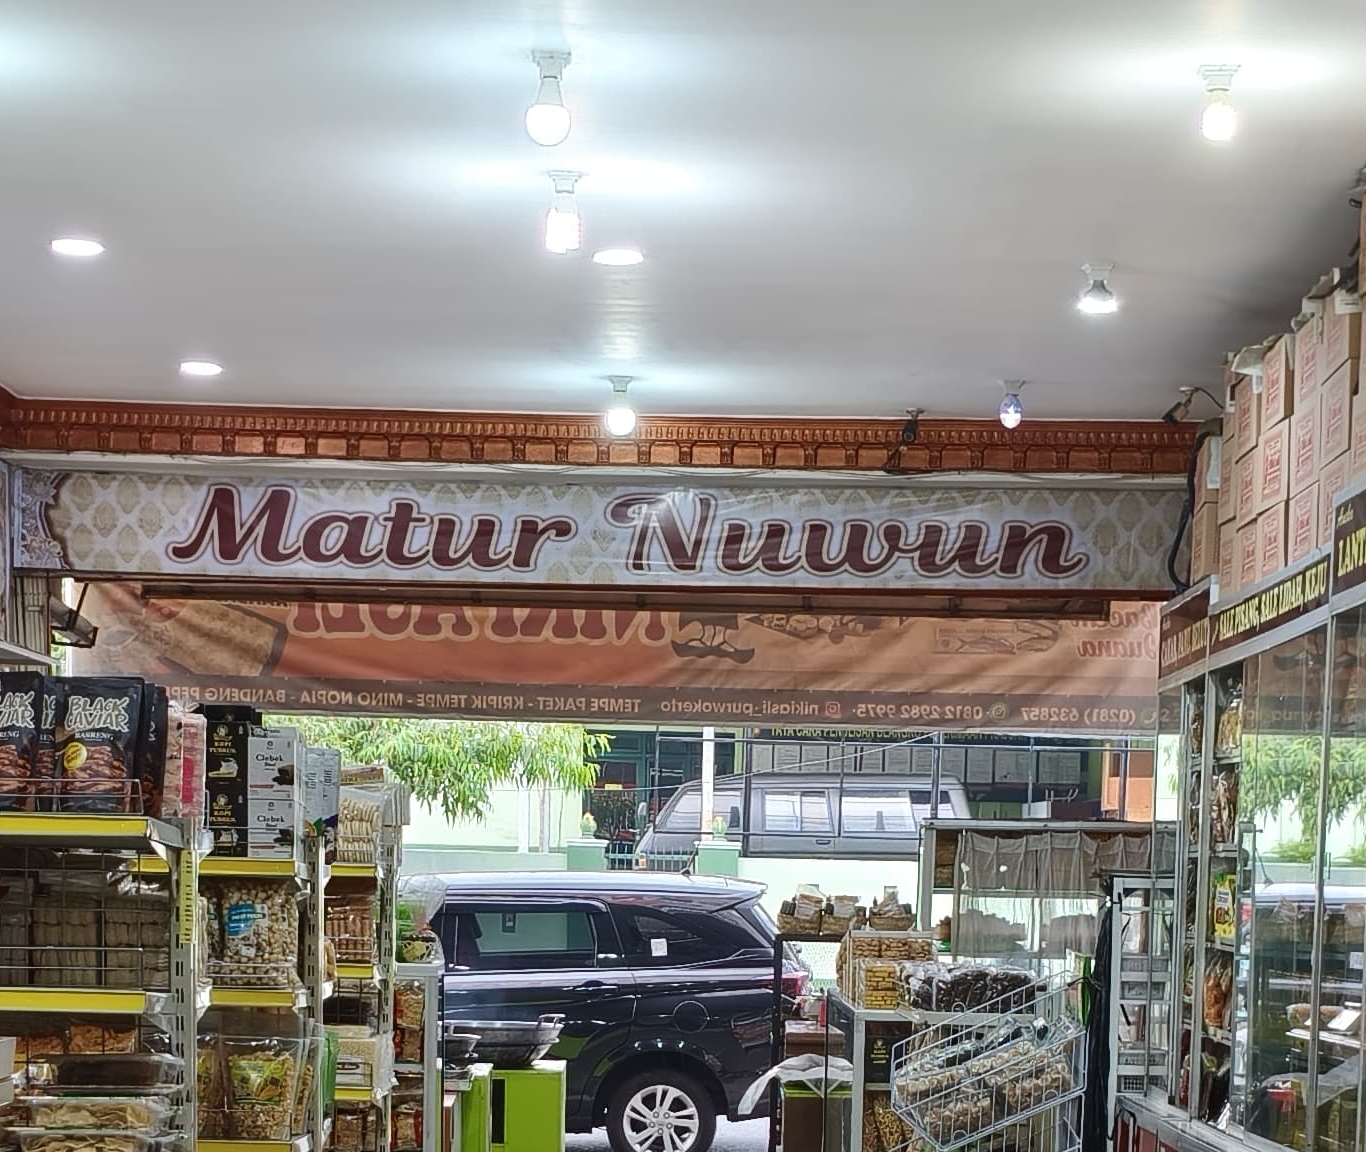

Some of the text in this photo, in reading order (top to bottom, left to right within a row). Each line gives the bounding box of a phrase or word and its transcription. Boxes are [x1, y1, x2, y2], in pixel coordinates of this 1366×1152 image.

[166, 484, 1089, 578] Matur Nuwun
[1219, 606, 1235, 641] SALE
[1260, 591, 1279, 625] SALE
[1304, 561, 1328, 604] KEJU
[65, 708, 130, 733] CAVIAR
[69, 695, 130, 715] BLACK
